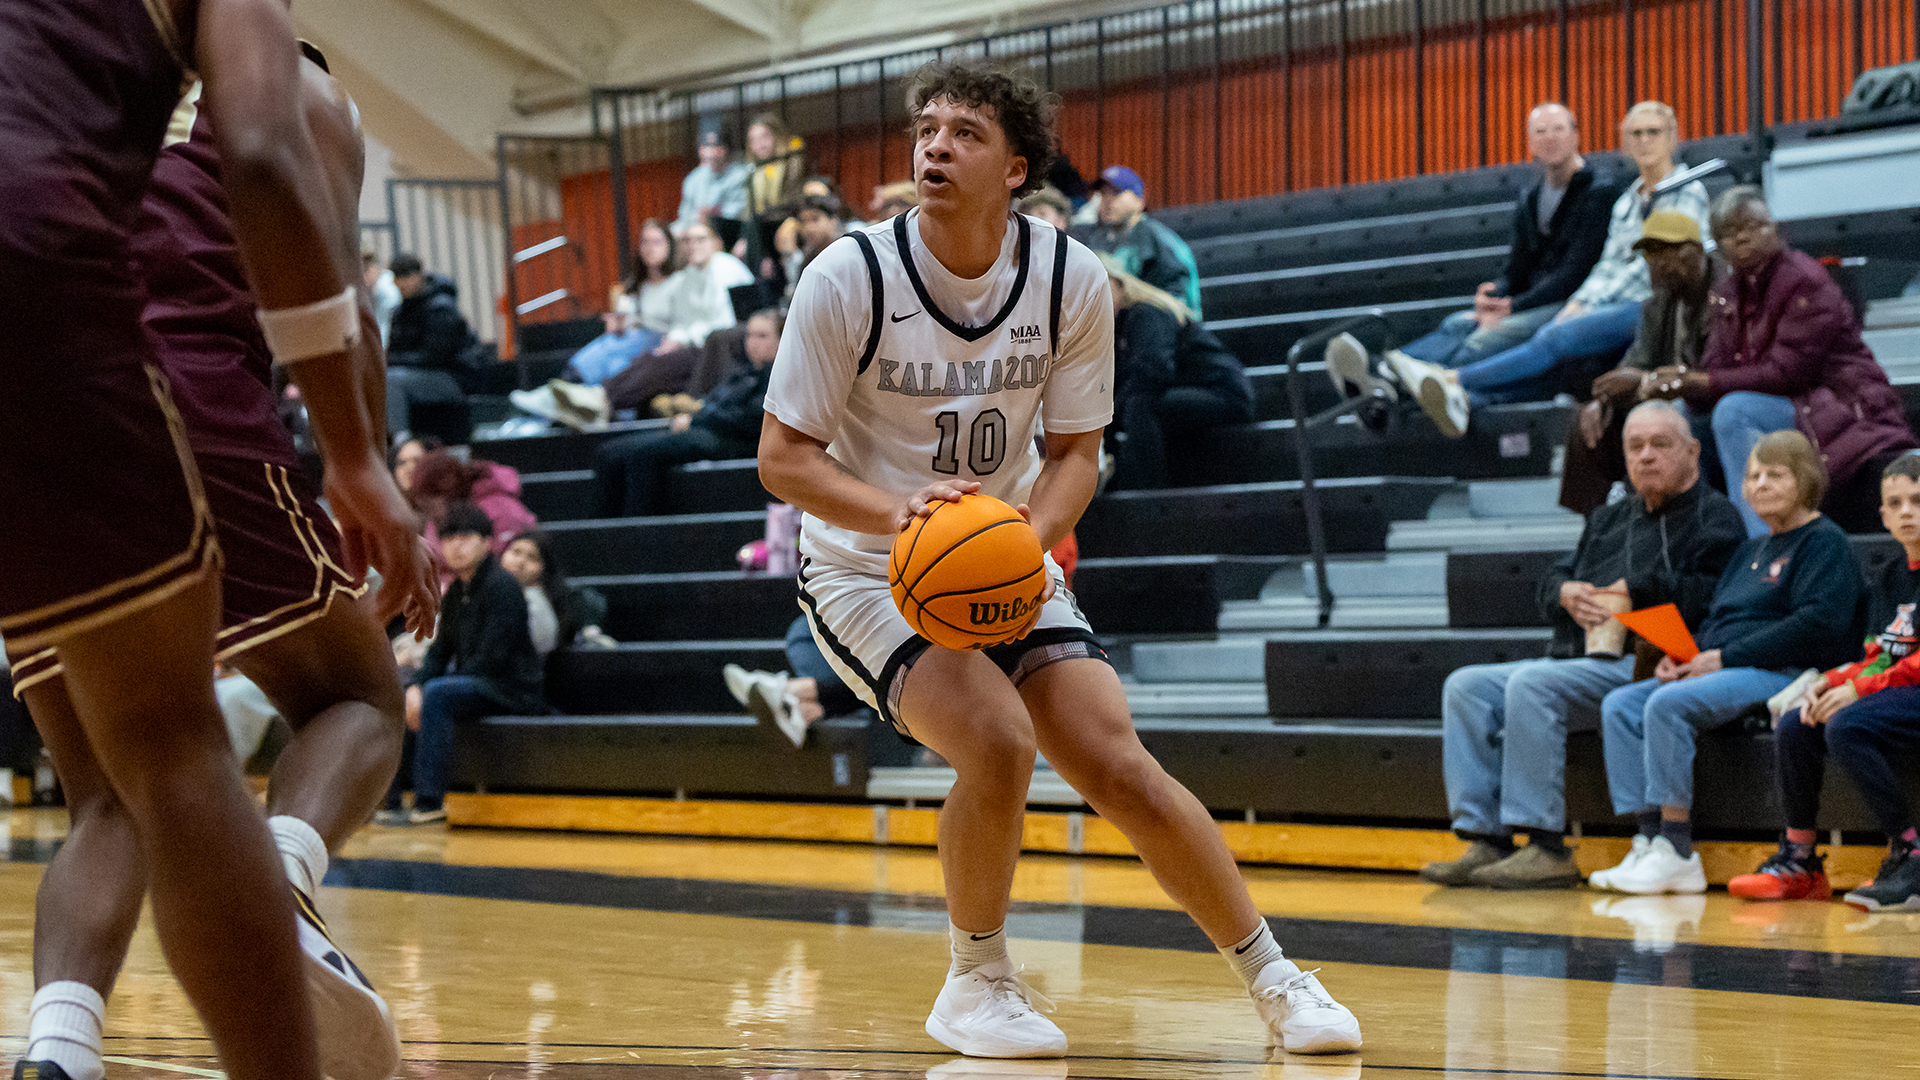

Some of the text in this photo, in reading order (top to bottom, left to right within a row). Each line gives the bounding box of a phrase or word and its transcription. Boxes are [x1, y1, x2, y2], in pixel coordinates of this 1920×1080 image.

[1010, 325, 1041, 340] MIAA
[877, 354, 1048, 397] KALAMAZOO
[932, 408, 1006, 476] 10
[969, 595, 1041, 625] Wilso
